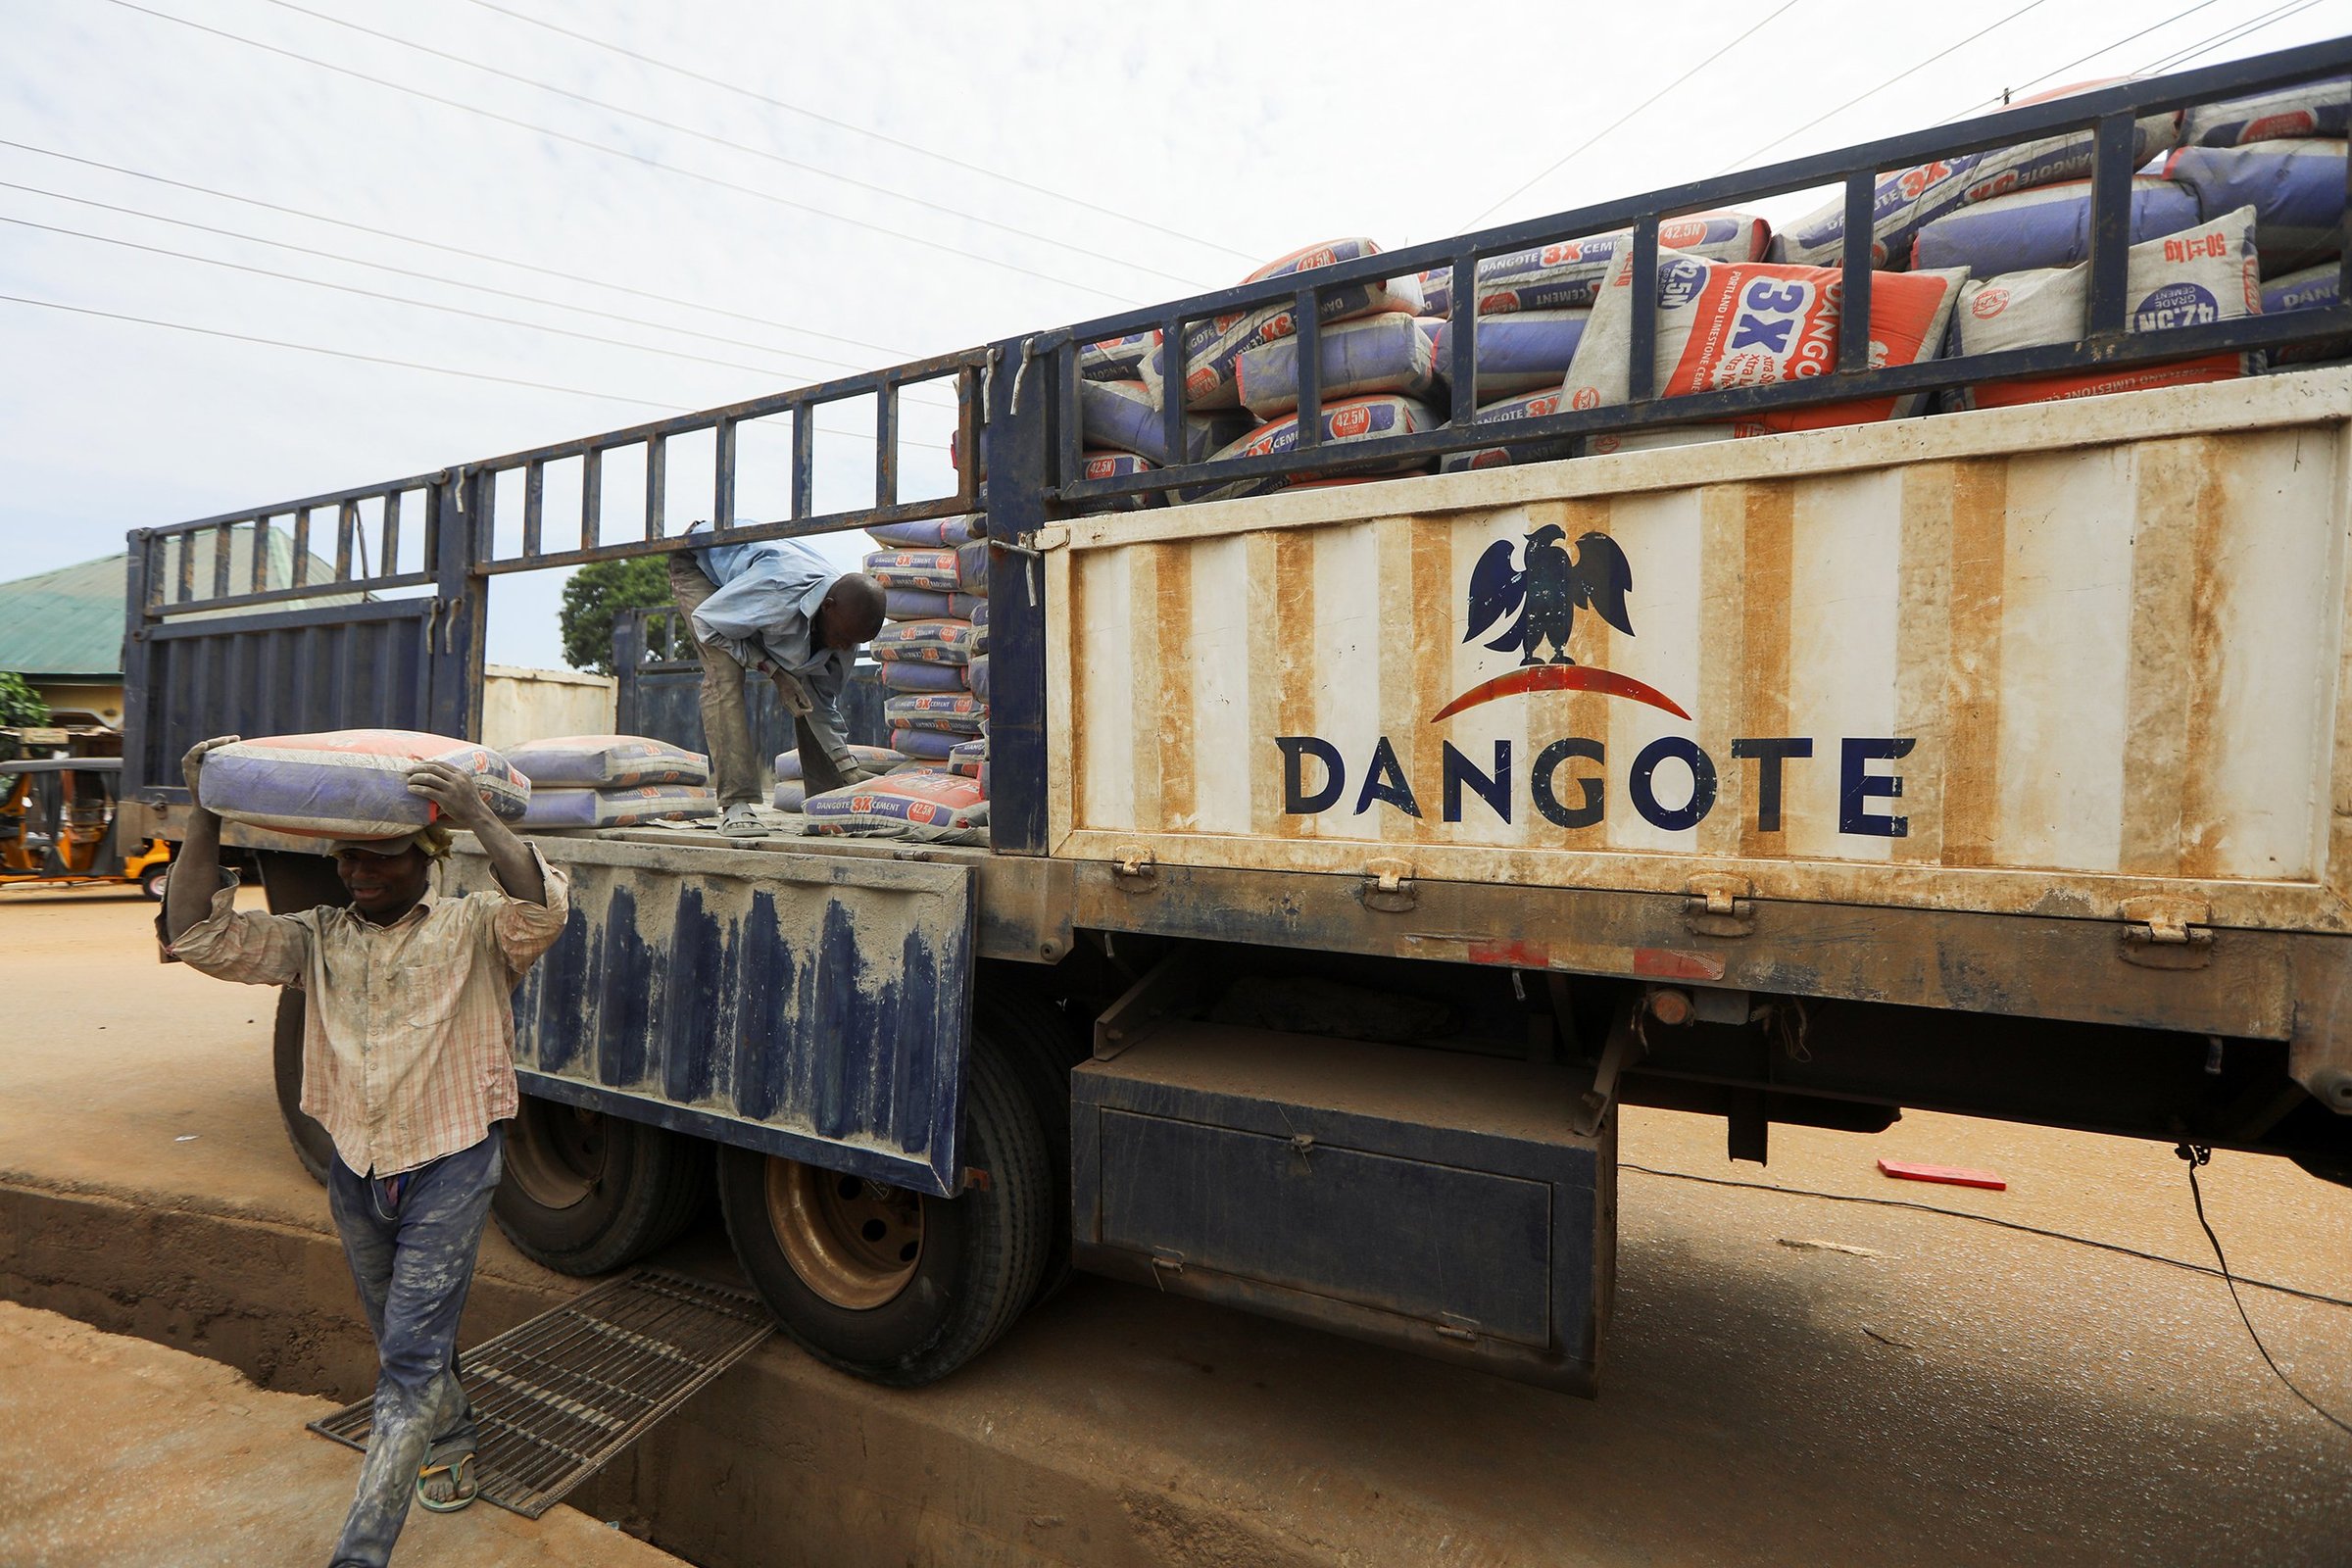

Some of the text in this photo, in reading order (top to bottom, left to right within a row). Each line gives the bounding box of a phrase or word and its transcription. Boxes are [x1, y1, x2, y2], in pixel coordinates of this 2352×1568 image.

[1664, 223, 1702, 240] 42.5N
[1480, 252, 1540, 273] DANGOTE
[1543, 243, 1582, 265] 3X
[1536, 286, 1589, 305] CEMENT
[2155, 285, 2196, 300] CEMENT
[2155, 294, 2196, 309] GRADE
[1731, 281, 1805, 354] 3X
[1189, 325, 1215, 349] GOTE
[1690, 270, 1741, 393] PORTLAND LIMESTONE CEME
[2064, 377, 2136, 399] LIMESTONE
[1336, 409, 1365, 427] 42.5N
[1090, 461, 1112, 473] 42.5N
[897, 555, 911, 565] 3X
[1274, 735, 1917, 837] DANGOTE
[853, 797, 871, 812] 3X
[872, 803, 901, 812] CEMENT
[911, 803, 934, 815] 42.5N
